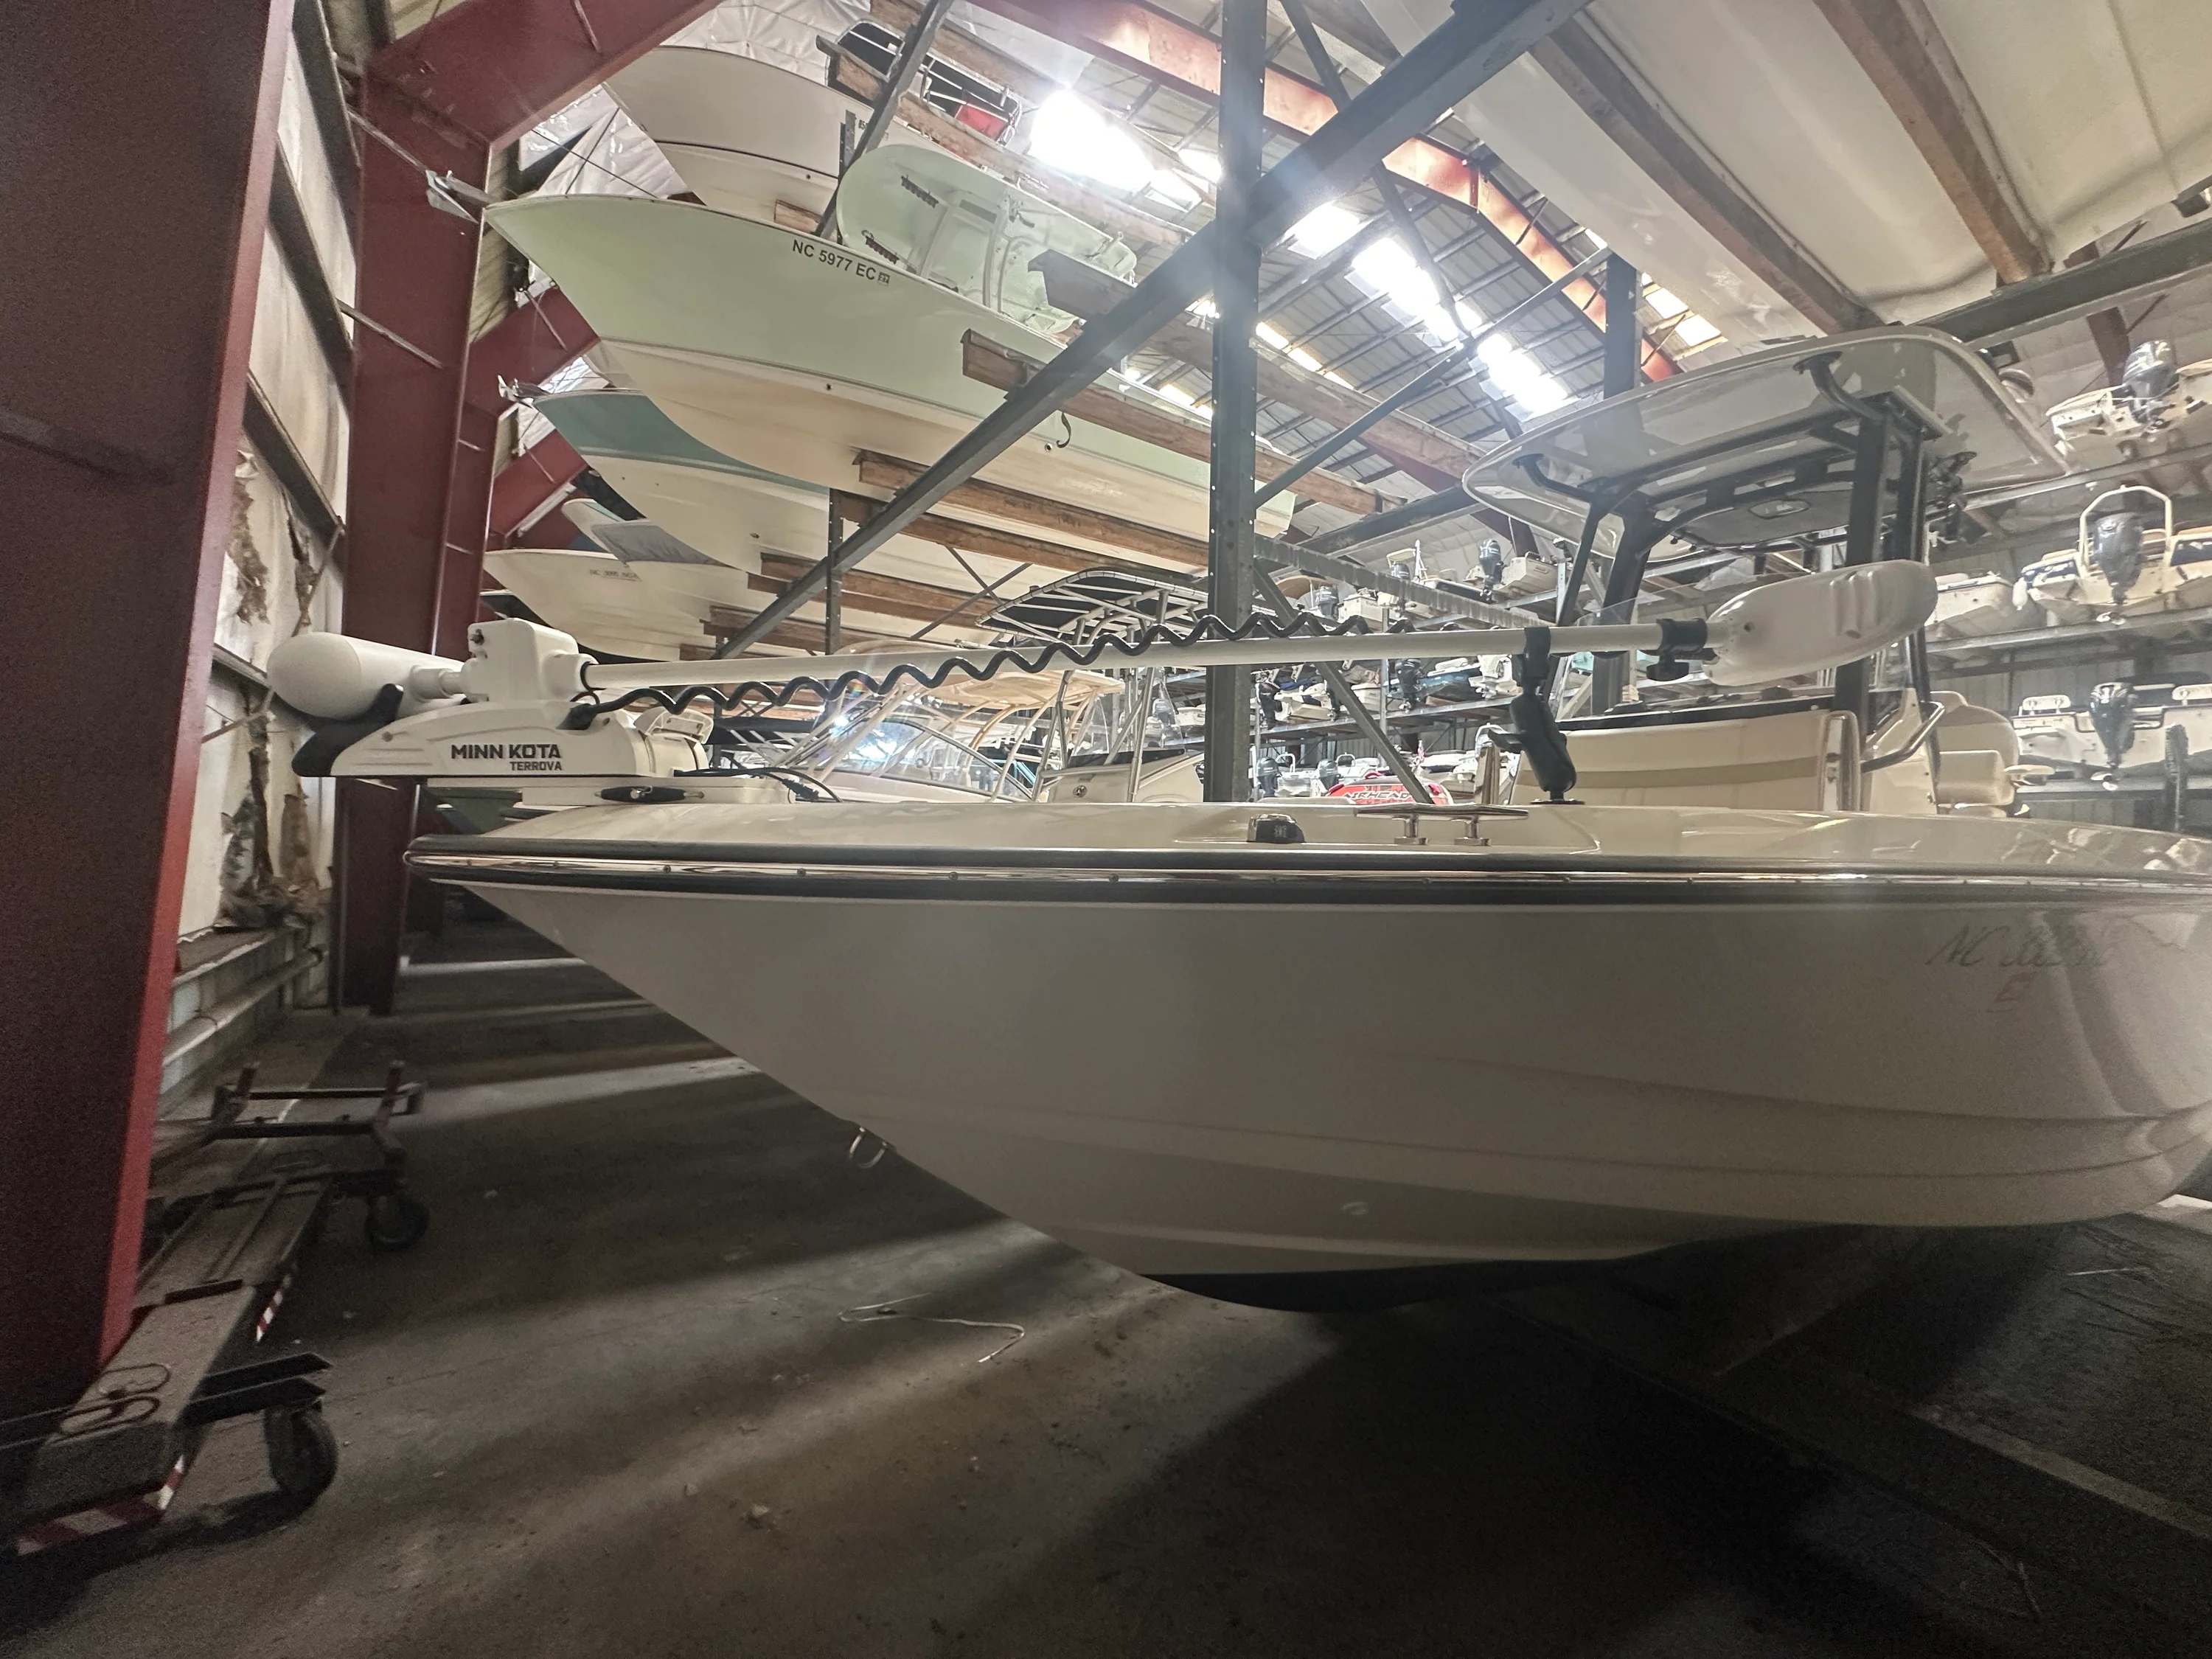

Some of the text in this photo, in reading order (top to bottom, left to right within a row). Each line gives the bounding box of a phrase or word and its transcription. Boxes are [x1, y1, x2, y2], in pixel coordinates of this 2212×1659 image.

[793, 239, 876, 280] NC 5977 EC
[451, 744, 561, 759] MINN KOTA
[509, 761, 563, 771] TERROVA
[1343, 791, 1413, 800] AIRHEAD
